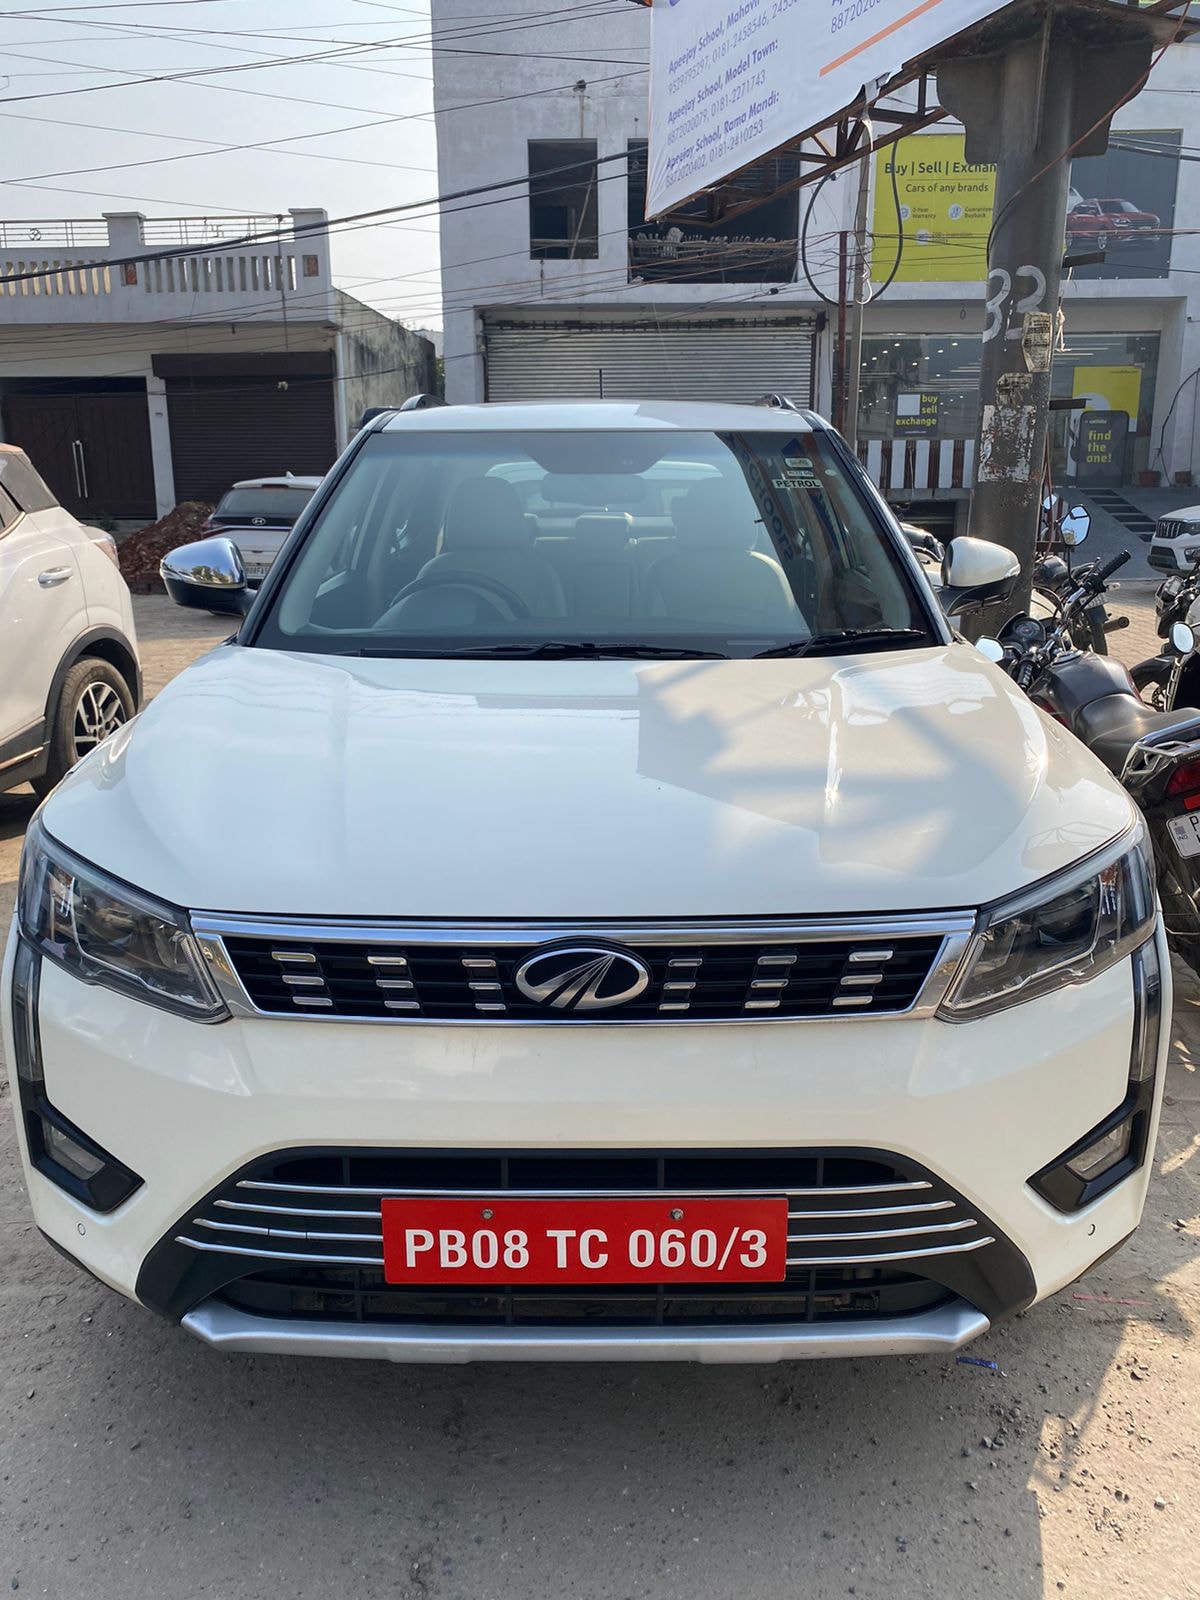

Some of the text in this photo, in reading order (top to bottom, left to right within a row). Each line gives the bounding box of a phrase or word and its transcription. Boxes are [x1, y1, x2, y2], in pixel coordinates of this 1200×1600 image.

[831, 0, 880, 33] 887202
[668, 45, 697, 74] Apeejay
[698, 21, 724, 51] School,
[668, 39, 778, 124] Apeejay School, Model Town:
[711, 69, 766, 117] 0181-2271743
[666, 90, 780, 170] Apeejay School, Rama Mandi:
[709, 119, 764, 163] 0181-2410253
[884, 162, 908, 176] Buy
[918, 161, 942, 174] Sell
[905, 183, 989, 194] Cars of any brands
[921, 394, 938, 404] buy
[921, 405, 938, 414] sell
[895, 417, 937, 427] exchange
[1088, 430, 1112, 441] find
[1087, 442, 1107, 452] the
[1086, 453, 1112, 463] one!
[776, 480, 820, 488] PETROL
[405, 1226, 768, 1271] PB08 TC 060/3
